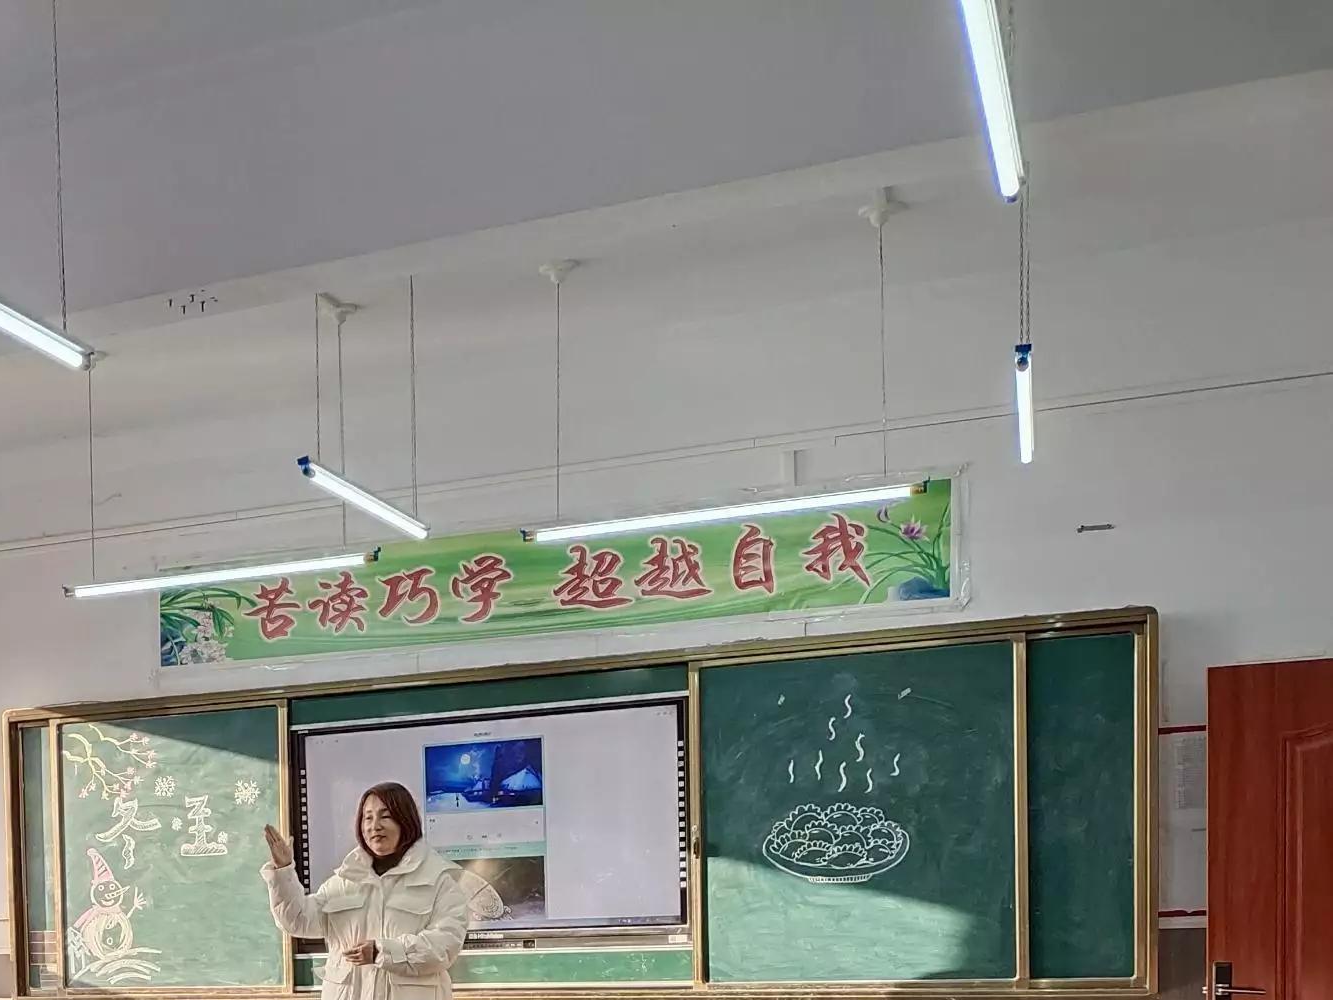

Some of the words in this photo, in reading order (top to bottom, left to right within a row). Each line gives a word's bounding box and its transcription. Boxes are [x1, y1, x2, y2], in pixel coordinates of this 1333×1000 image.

[242, 553, 513, 641] 苦读巧学
[552, 512, 872, 609] 超越自我
[95, 795, 229, 870] 冬至
